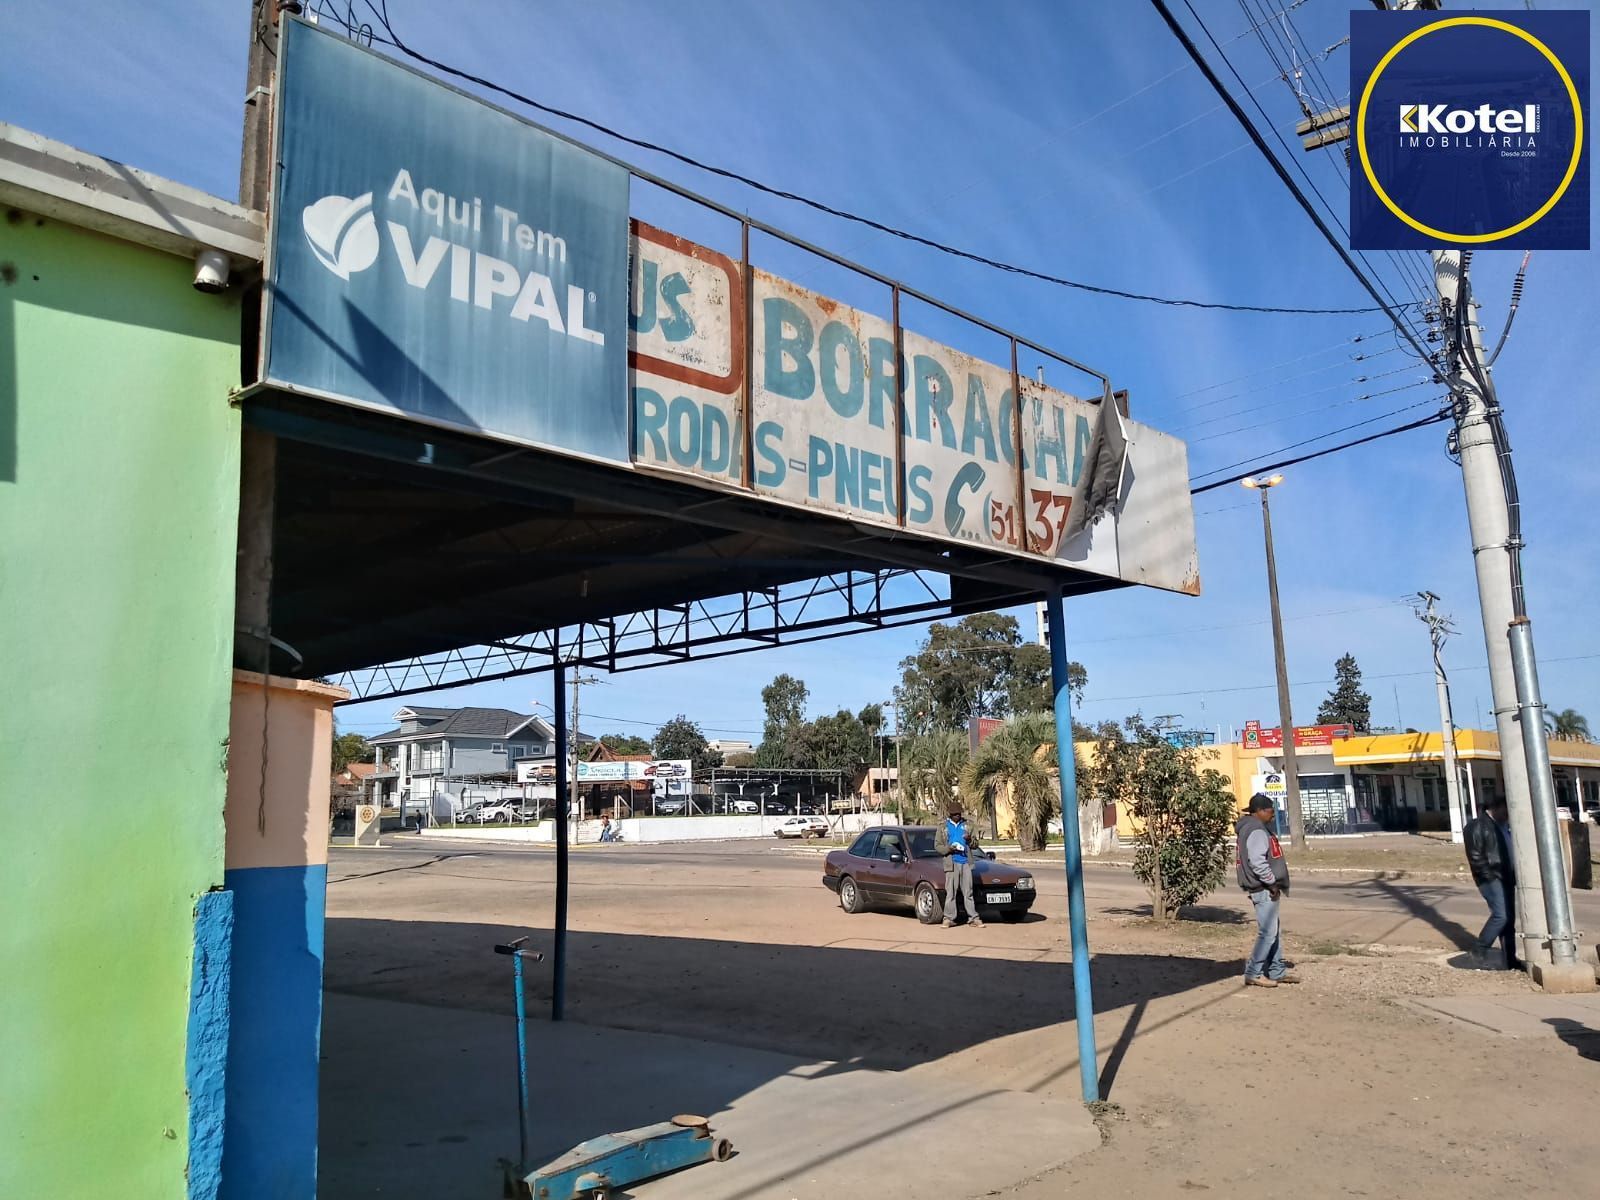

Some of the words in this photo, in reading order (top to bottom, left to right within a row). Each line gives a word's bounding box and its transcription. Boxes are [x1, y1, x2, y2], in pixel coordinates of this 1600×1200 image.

[388, 168, 482, 232] Aqui
[494, 204, 567, 262] Tem
[386, 219, 605, 346] VIPAL
